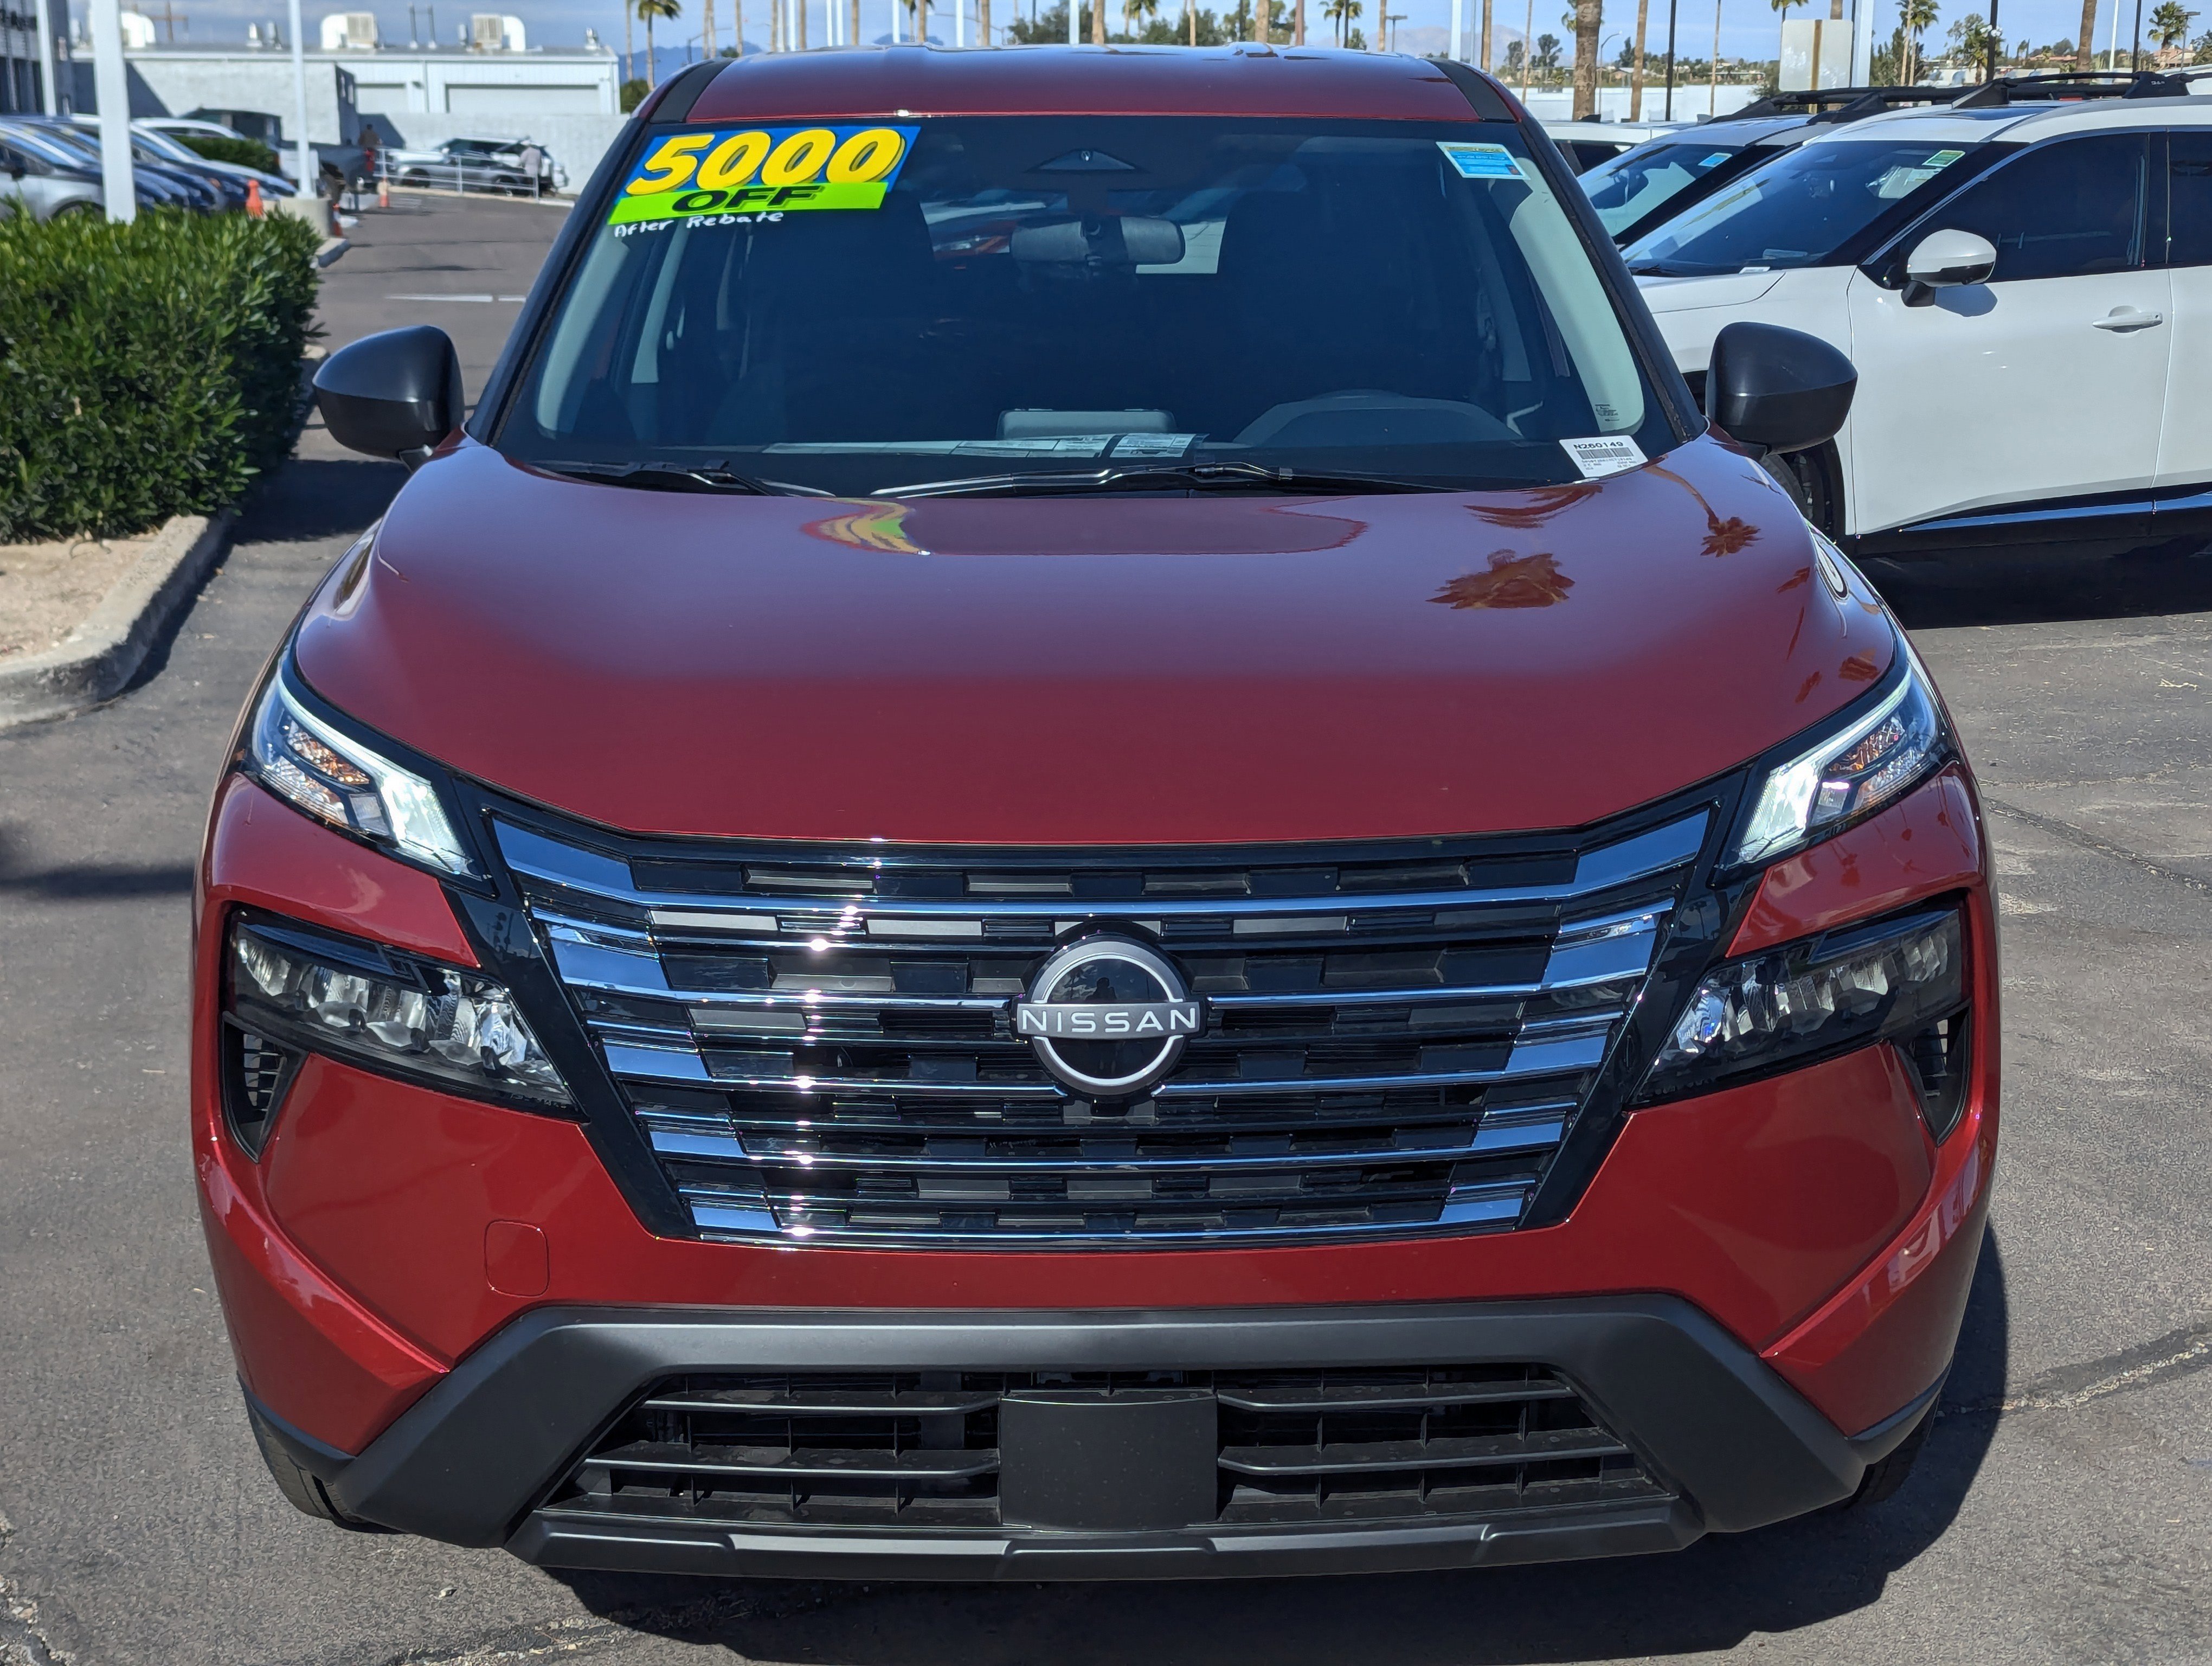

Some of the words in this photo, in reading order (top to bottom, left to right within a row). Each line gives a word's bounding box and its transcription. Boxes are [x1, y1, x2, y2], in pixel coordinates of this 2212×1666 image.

[626, 129, 905, 195] 5000
[672, 185, 824, 212] OFF
[614, 220, 674, 237] After
[686, 211, 784, 228] Rebate
[1023, 1008, 1195, 1033] NISSAN
